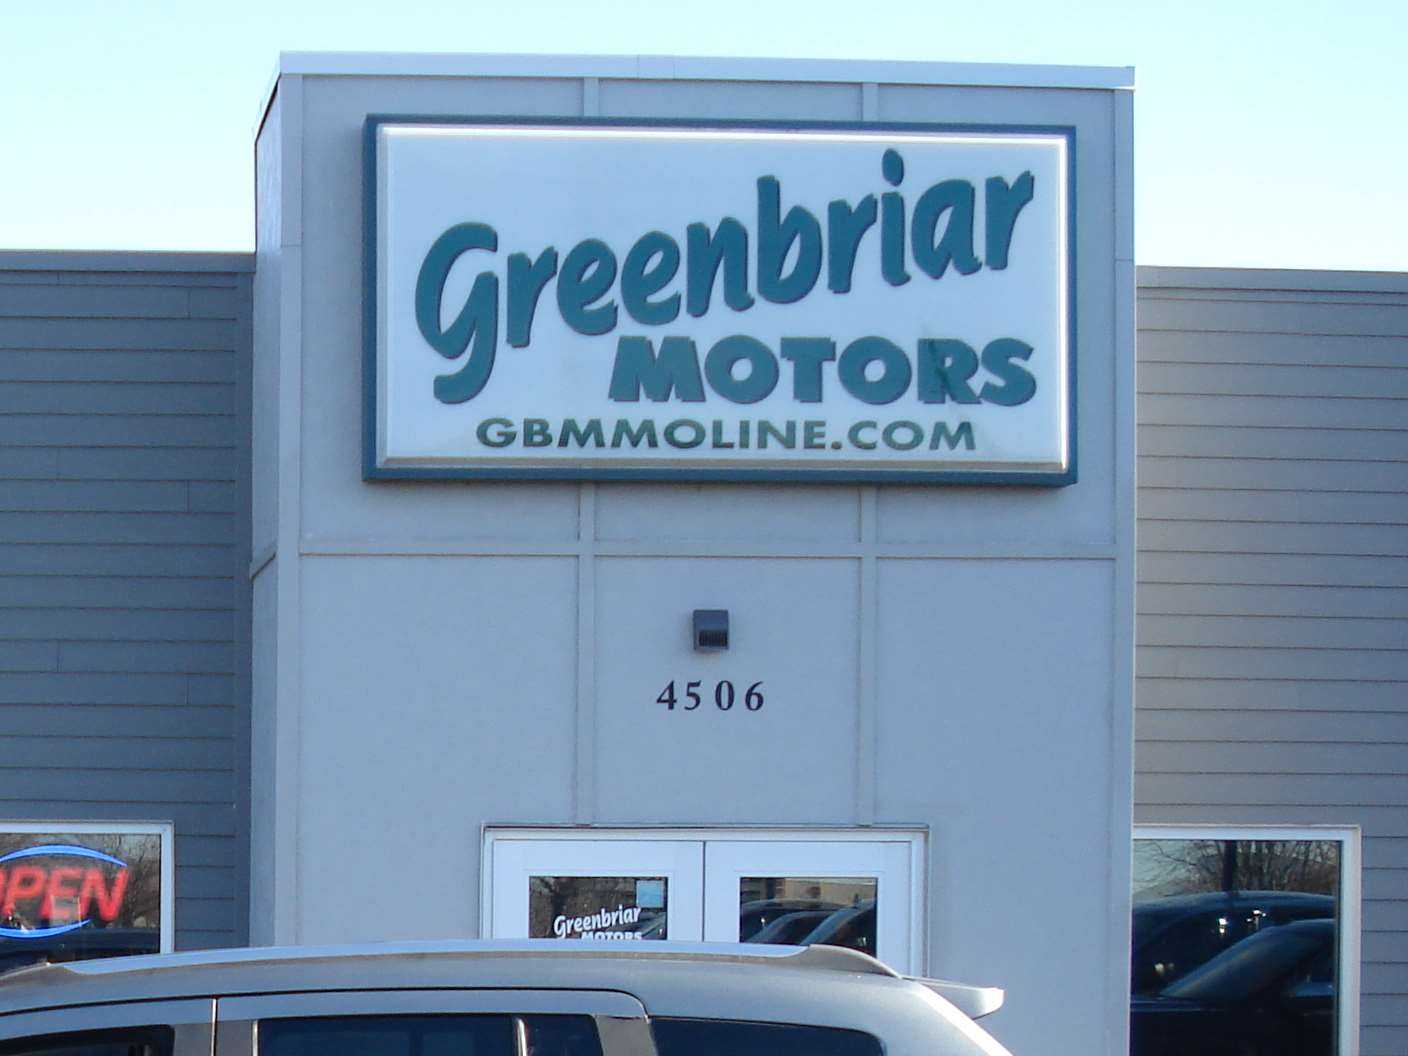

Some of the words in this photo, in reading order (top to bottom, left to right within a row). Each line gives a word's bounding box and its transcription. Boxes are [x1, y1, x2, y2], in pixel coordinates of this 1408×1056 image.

[415, 149, 1034, 404] Greenbriar
[608, 335, 1037, 406] MOTORS
[476, 417, 976, 452] GBMMOLINE.COM
[656, 680, 765, 711] 4506
[553, 904, 641, 940] Greenbriar
[580, 931, 642, 940] MOTORS
